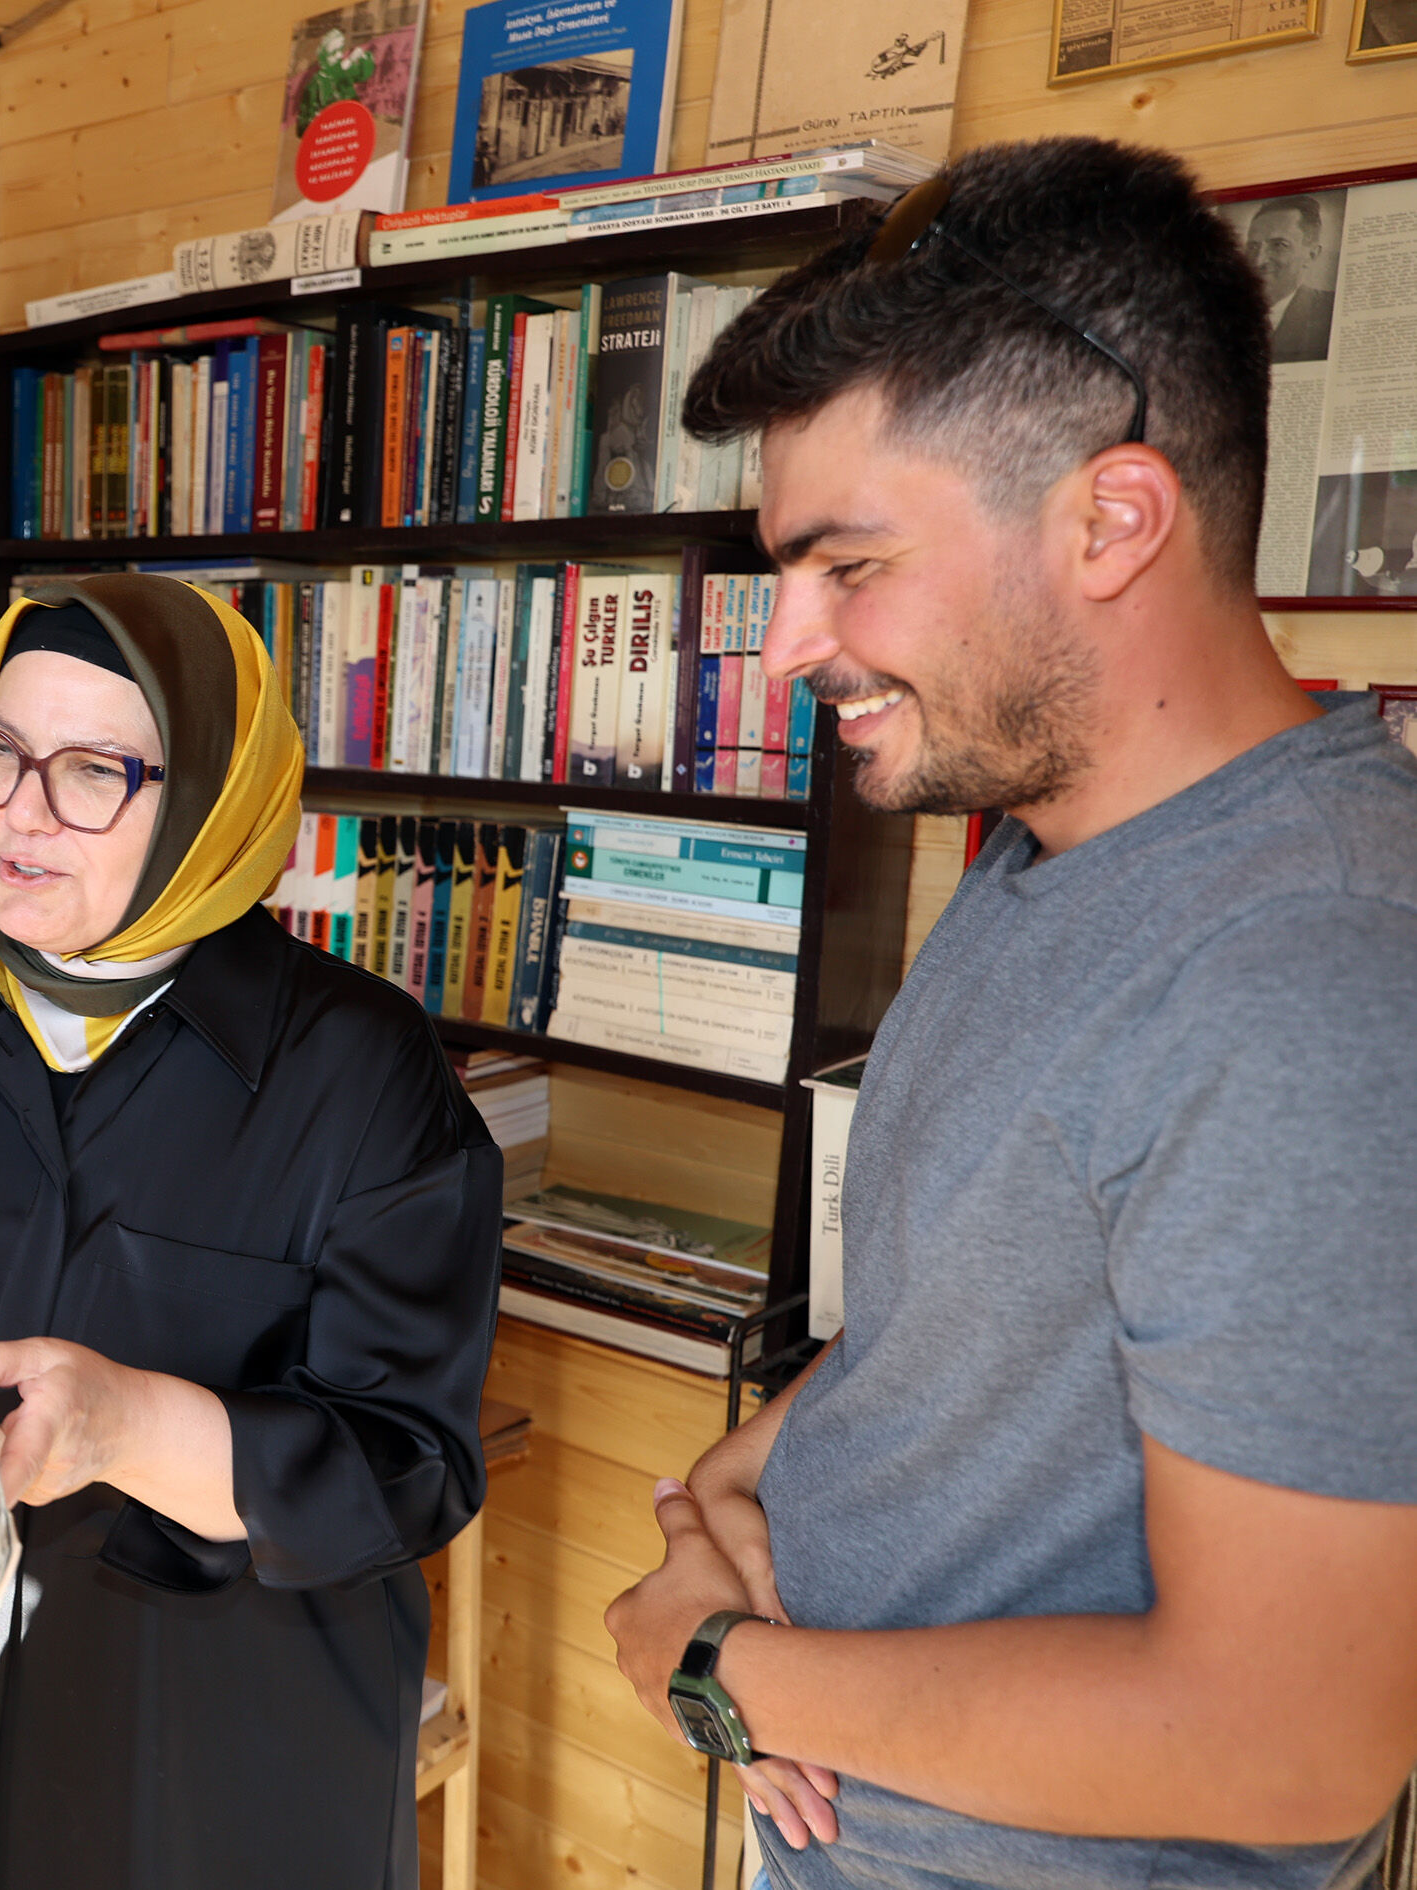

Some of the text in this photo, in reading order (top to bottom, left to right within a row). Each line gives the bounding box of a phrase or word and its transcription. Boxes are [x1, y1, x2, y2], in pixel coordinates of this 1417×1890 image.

[801, 105, 908, 133] Güray TAPTIK
[603, 290, 663, 311] LAWRENCE
[602, 309, 661, 329] FREEDMAN
[600, 329, 662, 352] STRATEJİ
[478, 358, 505, 492] KÜRDOLOJİ YALANLARI
[581, 596, 601, 668] Şu Çılgın
[720, 846, 785, 866] Ermeni Tehciri
[493, 958, 508, 991] KUTSAL
[822, 1153, 840, 1187] Dili
